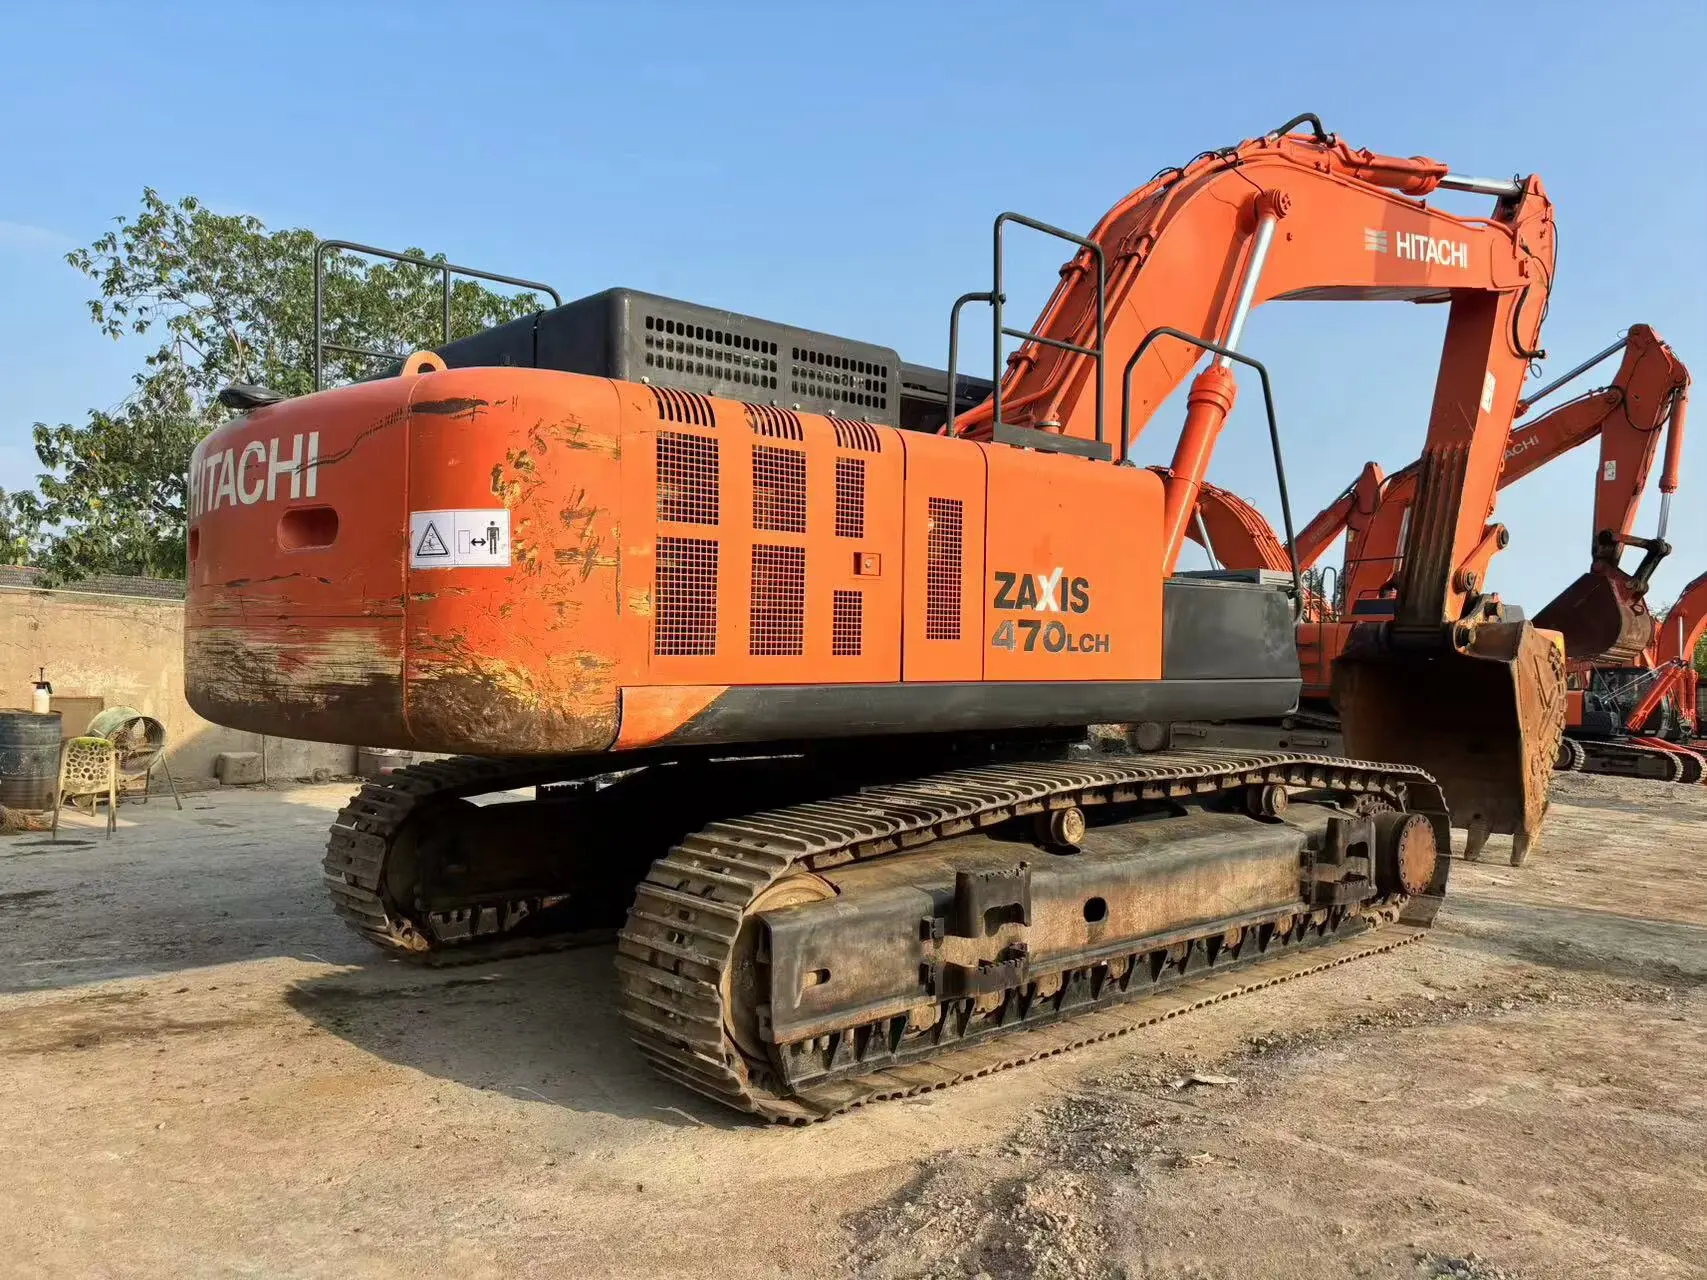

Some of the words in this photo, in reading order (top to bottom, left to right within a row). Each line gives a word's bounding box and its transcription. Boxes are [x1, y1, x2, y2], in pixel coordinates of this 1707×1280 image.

[1396, 231, 1468, 269] HITACHI
[1504, 435, 1540, 461] ACHI
[189, 431, 320, 518] HITACHI
[993, 567, 1090, 614] ZAXIS
[991, 619, 1111, 653] 470LCH
